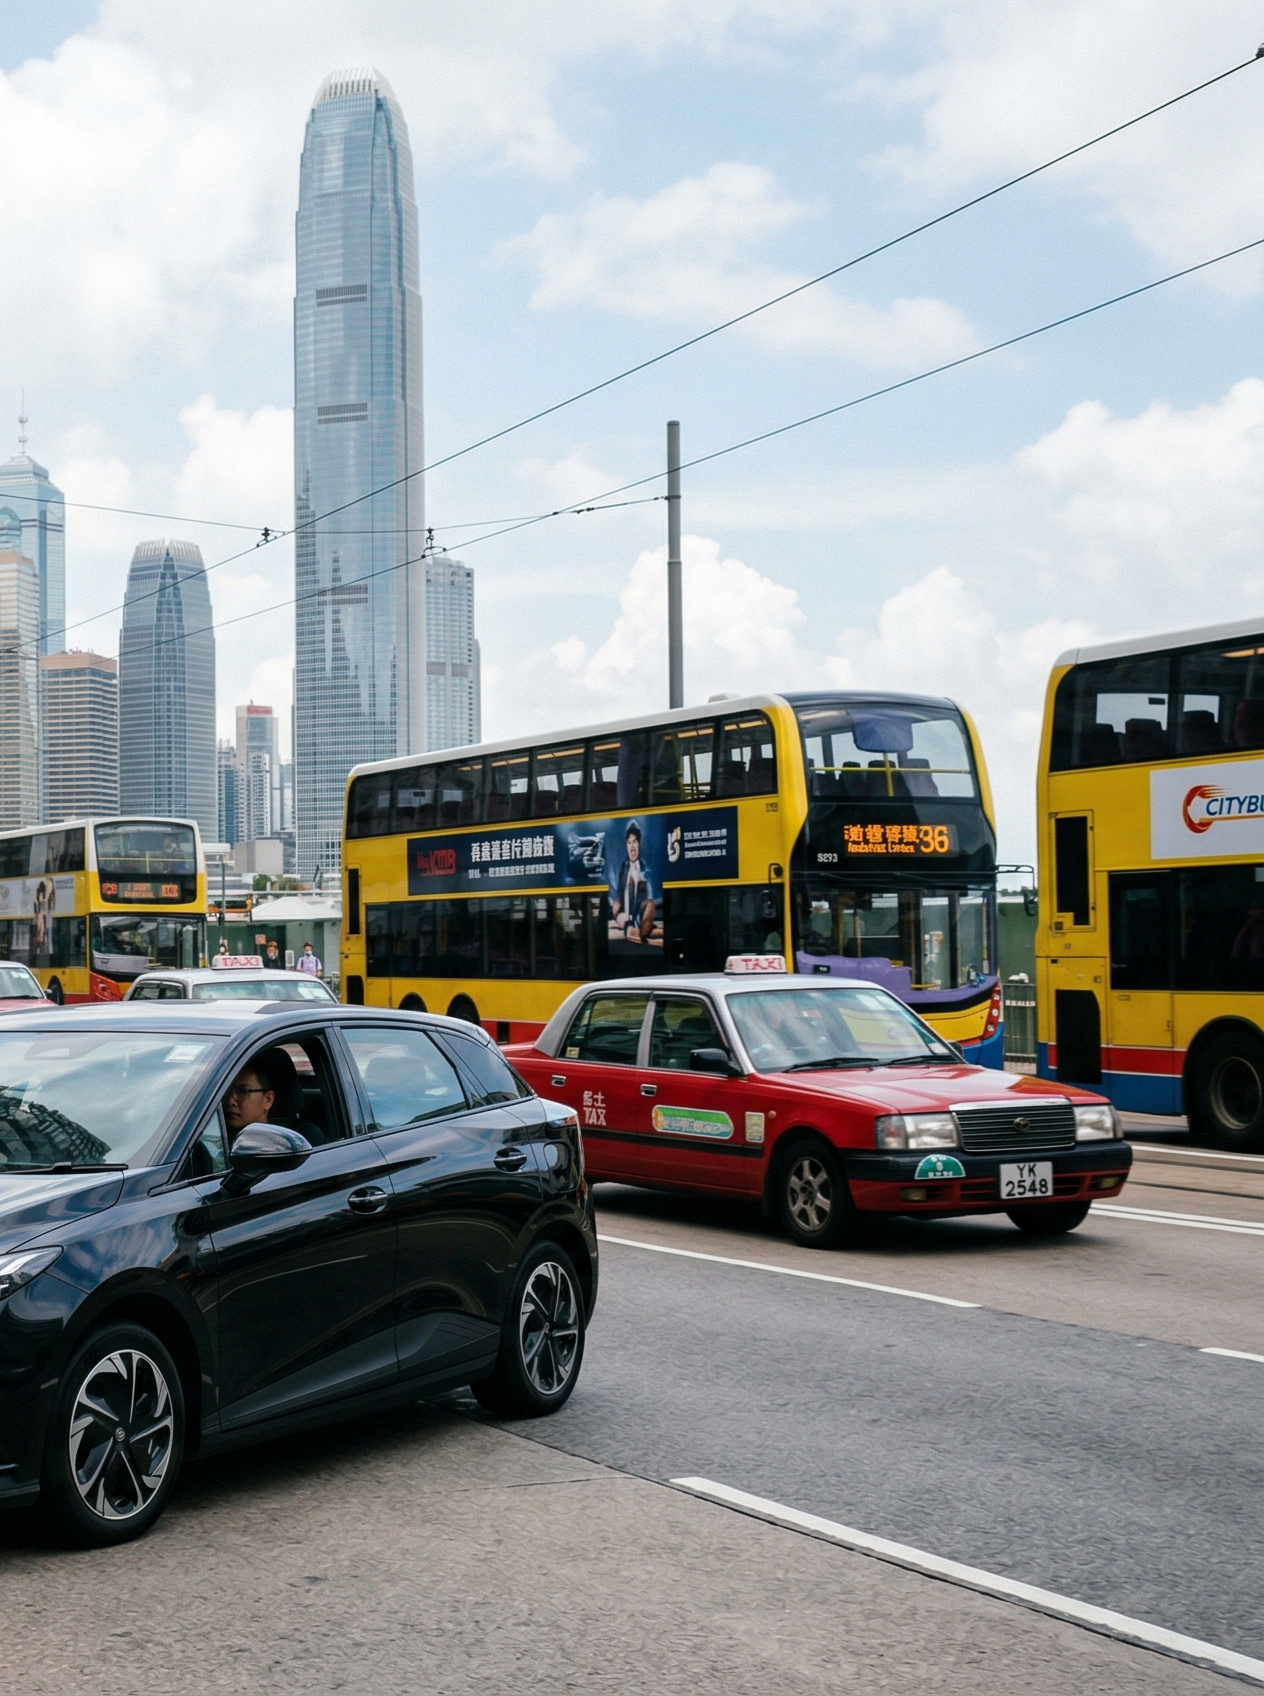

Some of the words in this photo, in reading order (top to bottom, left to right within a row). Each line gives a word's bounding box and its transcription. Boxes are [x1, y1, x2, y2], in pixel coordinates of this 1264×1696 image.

[919, 825, 950, 853] 36
[1017, 1163, 1037, 1179] YK
[1005, 1178, 1049, 1197] 2548
